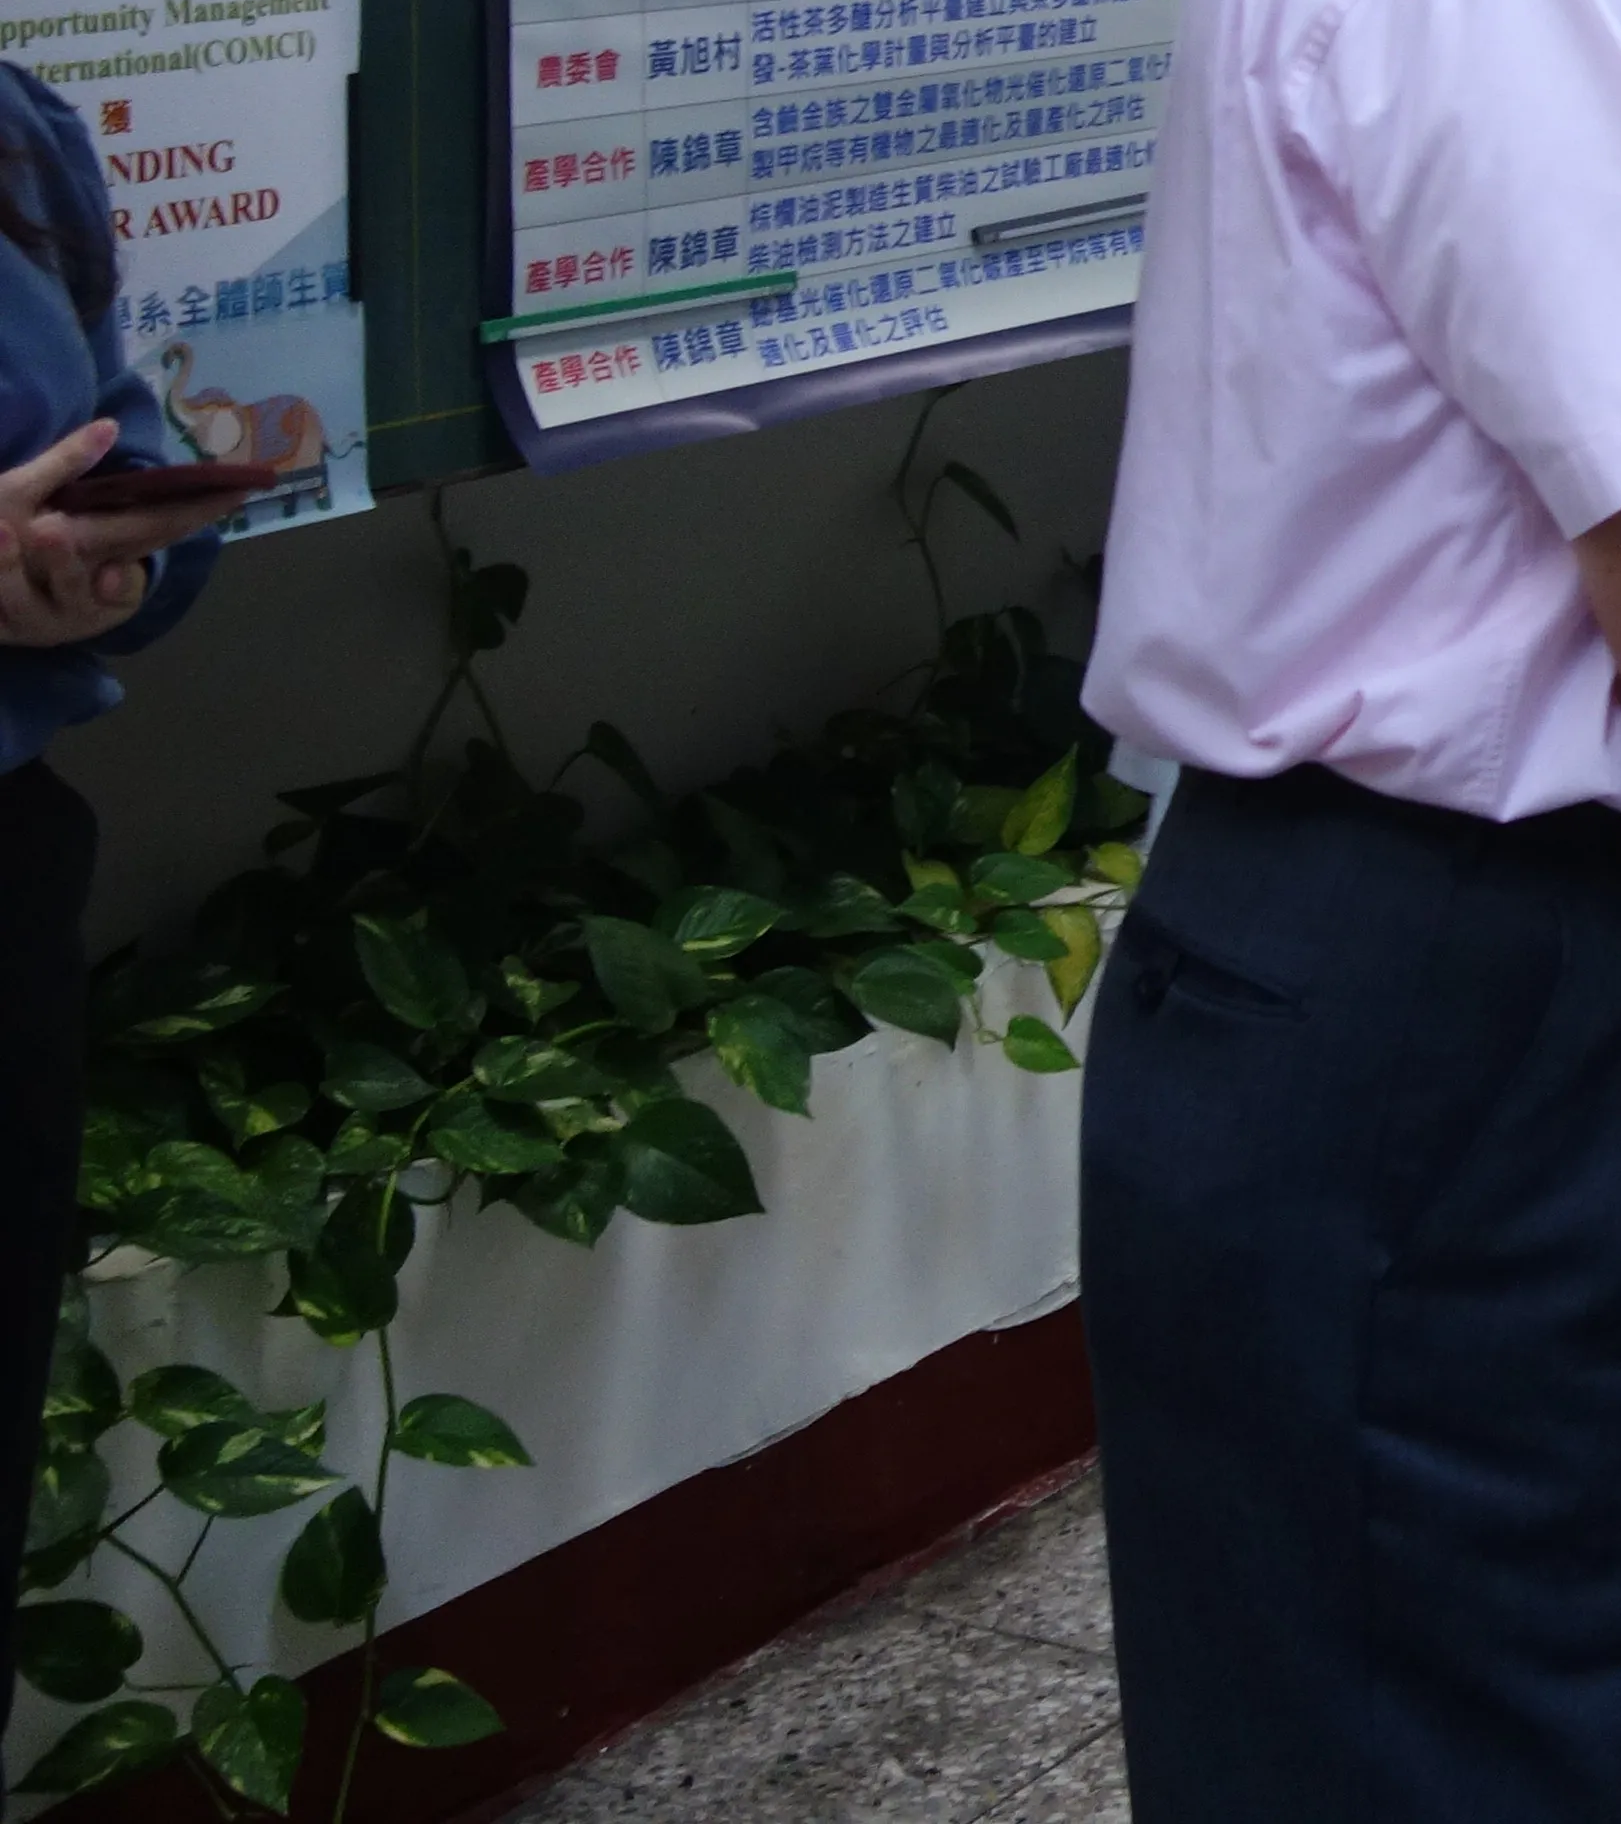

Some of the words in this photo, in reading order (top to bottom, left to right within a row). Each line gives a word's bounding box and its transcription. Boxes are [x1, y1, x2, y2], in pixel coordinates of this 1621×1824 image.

[29, 29, 317, 84] ternational(COMCI)
[523, 147, 636, 193] 產學合作
[143, 187, 282, 239] AWARD
[526, 247, 635, 294] 產學合作
[532, 345, 641, 393] 產學合作
